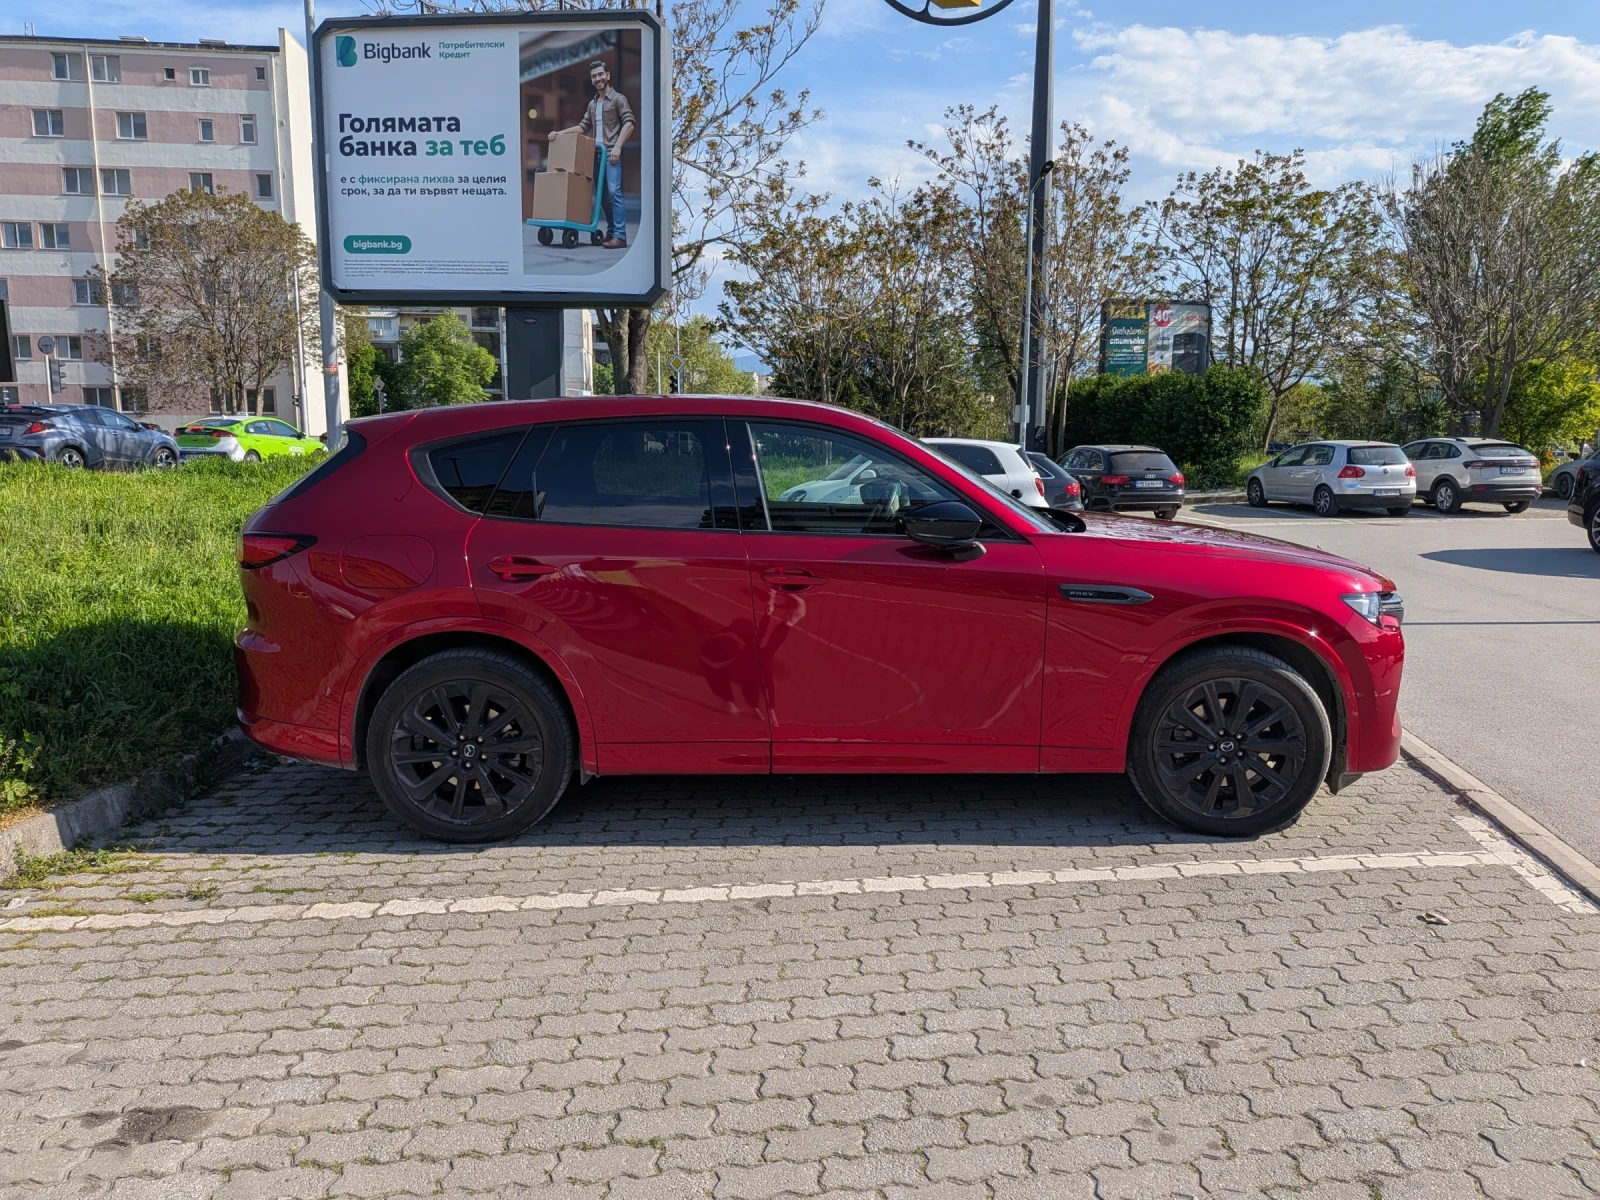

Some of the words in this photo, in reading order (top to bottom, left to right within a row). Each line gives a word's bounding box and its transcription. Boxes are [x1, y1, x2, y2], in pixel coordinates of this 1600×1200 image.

[438, 41, 505, 50] Потребителски
[363, 42, 432, 63] Bigbank
[438, 51, 471, 60] Кредит
[338, 113, 461, 133] Голямата
[339, 135, 417, 157] банка
[425, 140, 453, 156] за
[459, 134, 506, 156] теб
[340, 176, 347, 184] е
[350, 176, 356, 184] с
[358, 174, 419, 186] фиксирана
[422, 176, 455, 184] лихва
[457, 176, 470, 184] за
[472, 176, 507, 185] целия
[341, 188, 370, 197] срок,
[373, 187, 385, 195] за
[387, 187, 401, 197] да
[420, 187, 459, 197] вървят
[462, 187, 507, 197] нещата.
[353, 240, 403, 250] bigbank.bg
